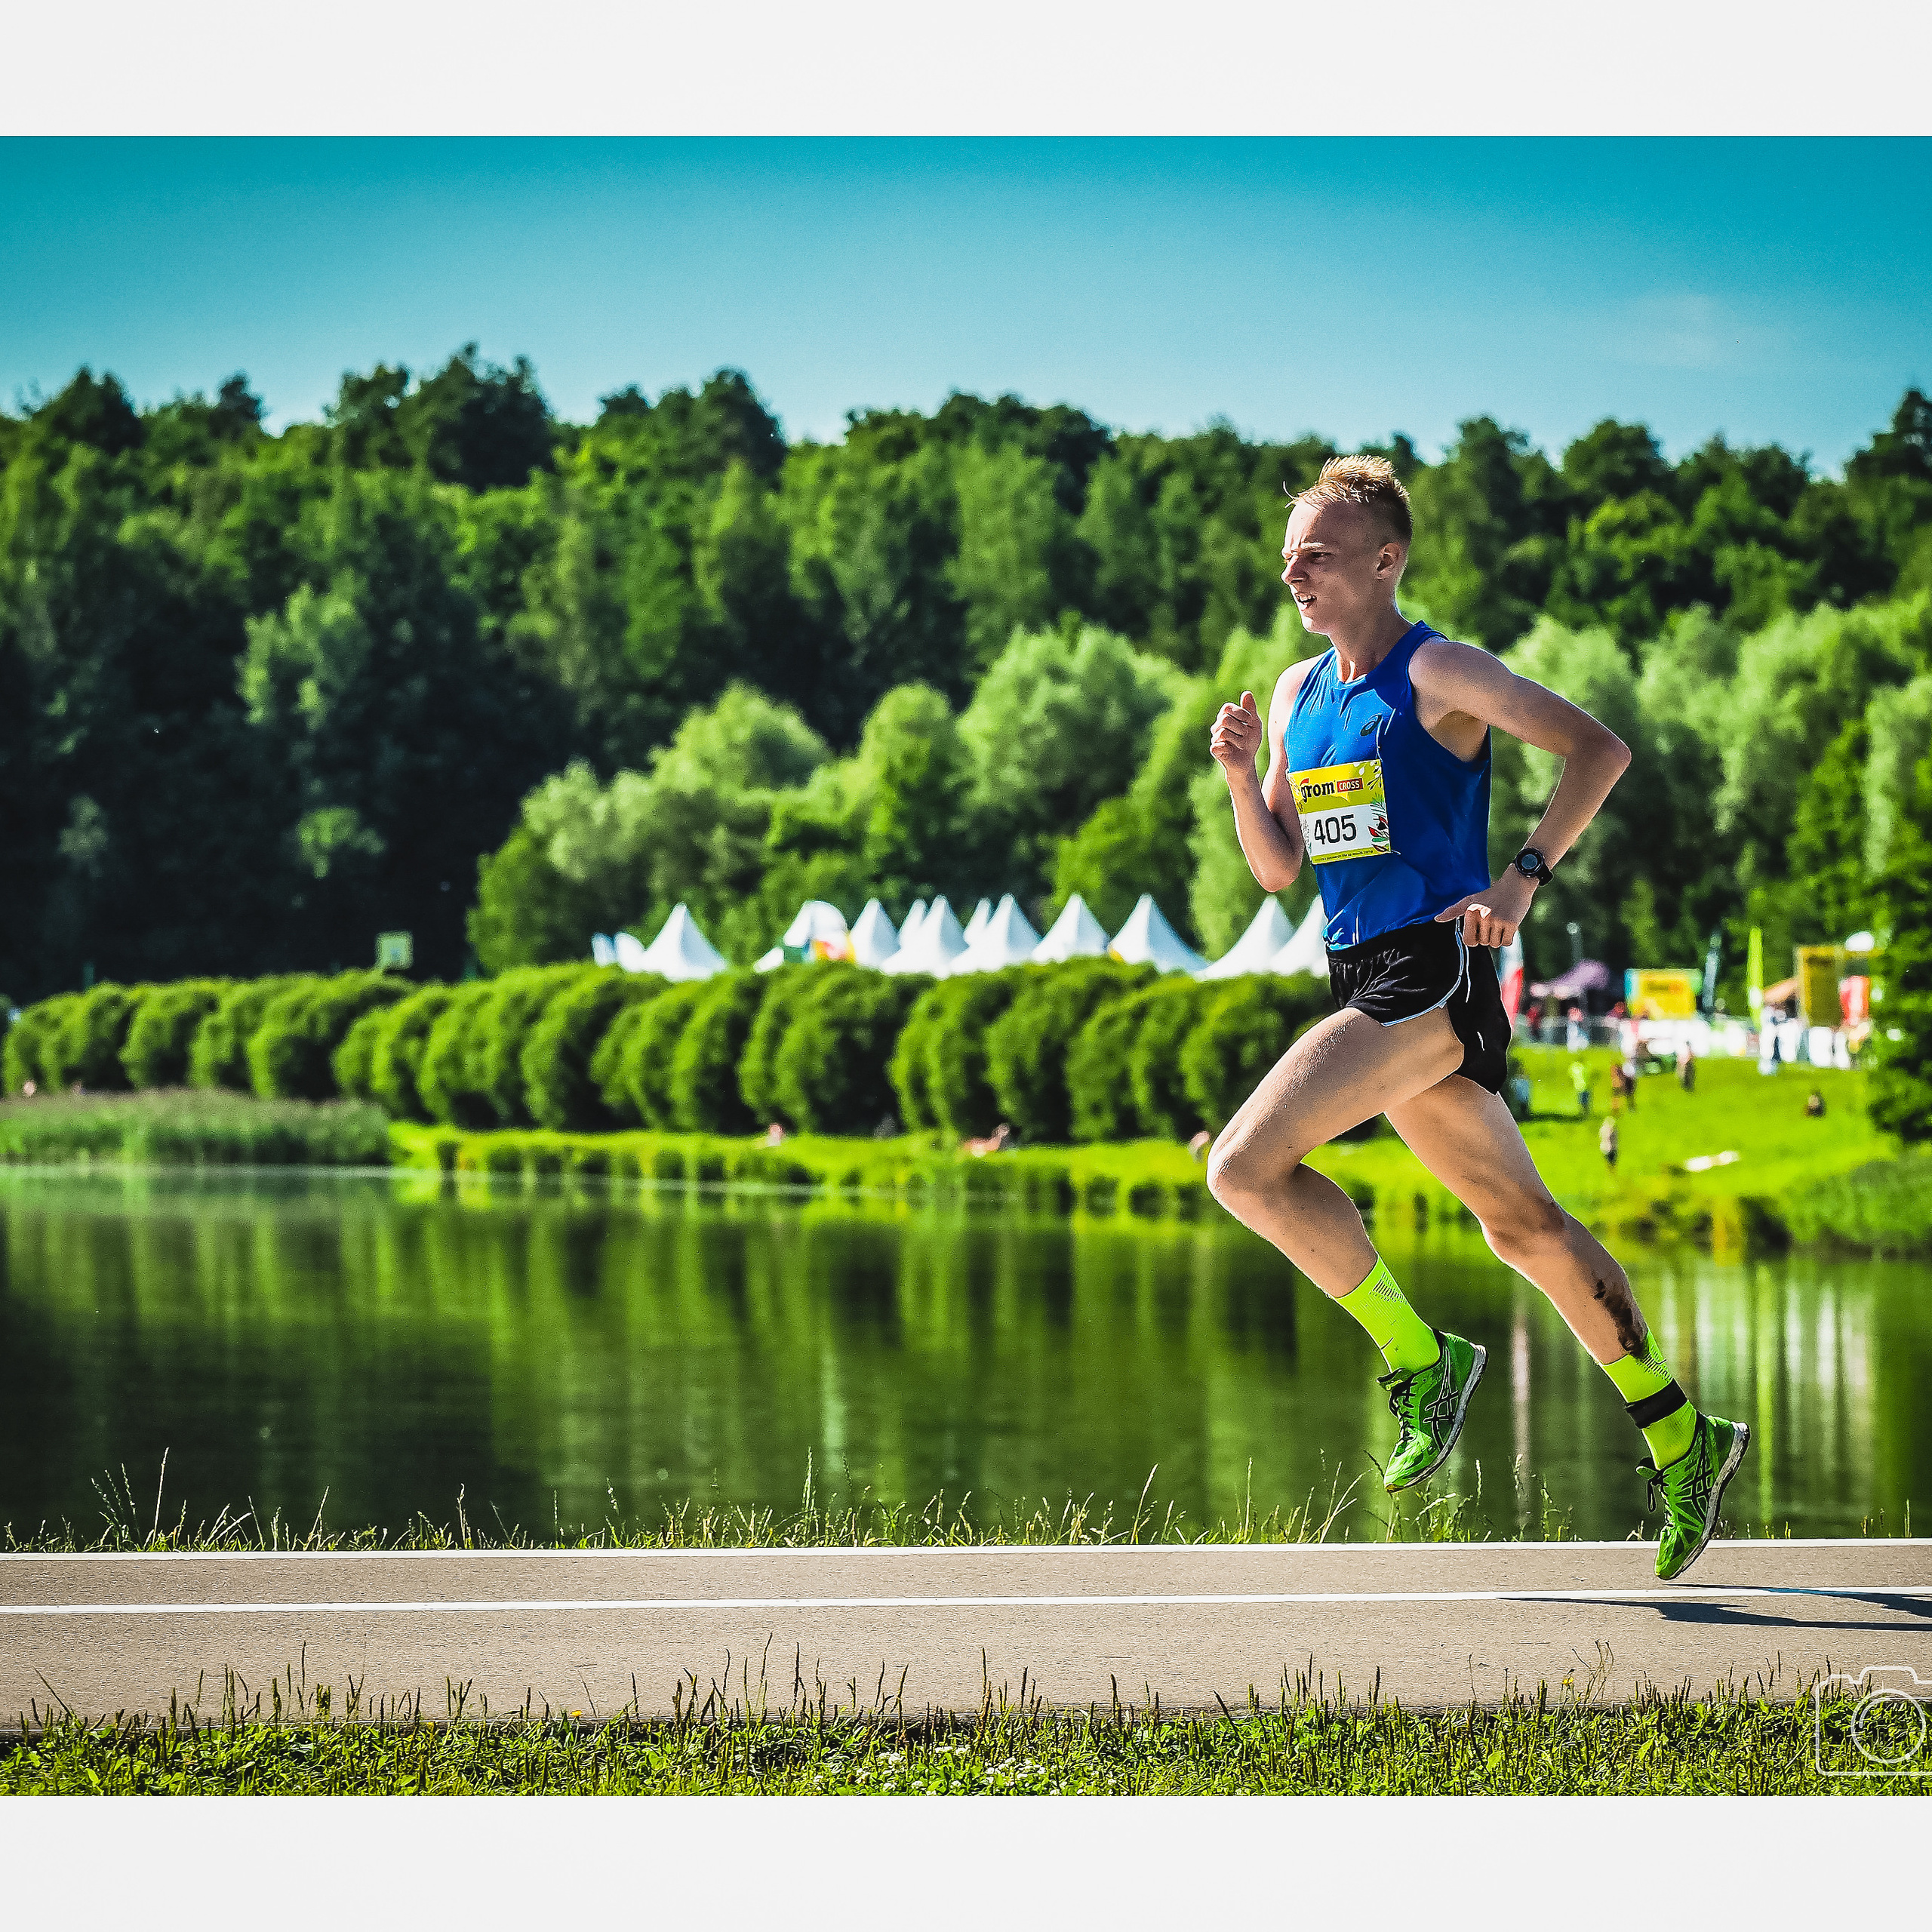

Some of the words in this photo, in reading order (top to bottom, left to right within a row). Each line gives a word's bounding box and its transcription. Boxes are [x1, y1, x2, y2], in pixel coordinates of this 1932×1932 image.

[1300, 778, 1335, 803] grom
[1339, 780, 1360, 791] CROSS
[1314, 814, 1357, 844] 405
